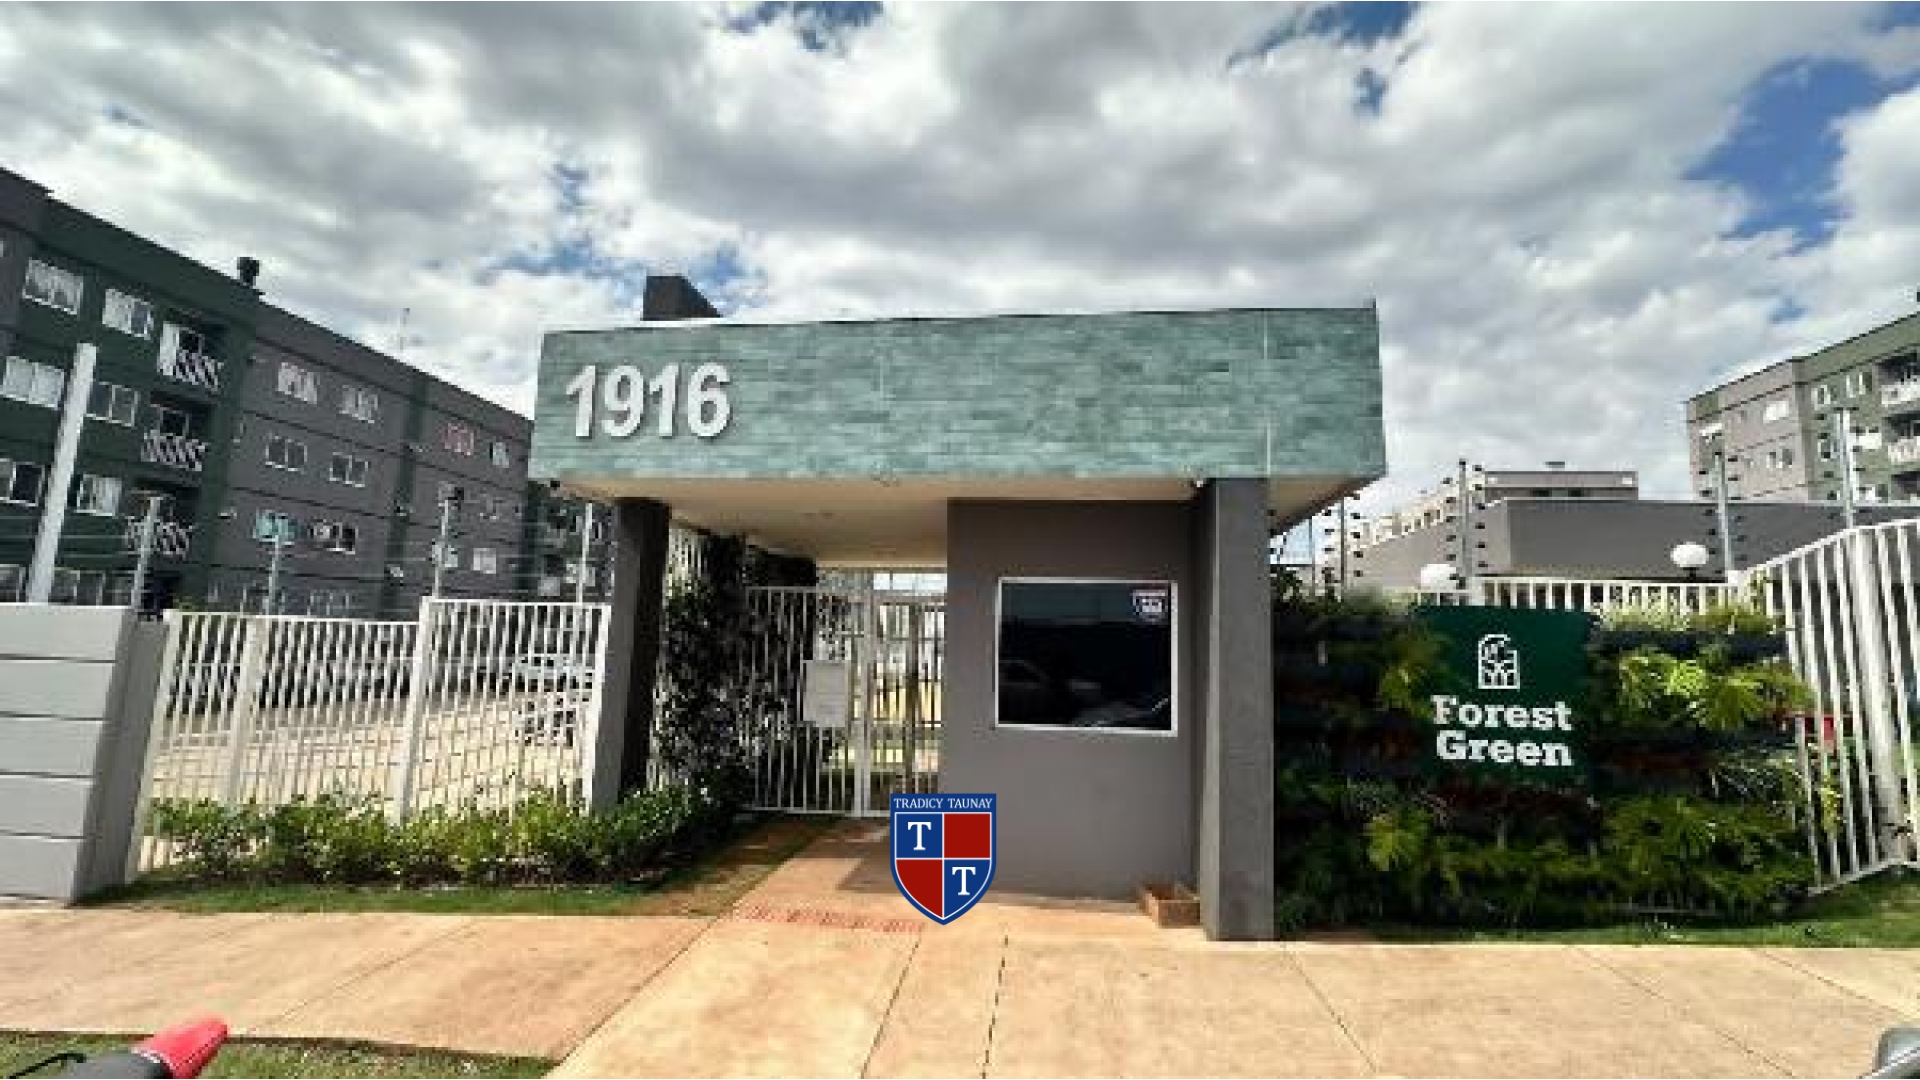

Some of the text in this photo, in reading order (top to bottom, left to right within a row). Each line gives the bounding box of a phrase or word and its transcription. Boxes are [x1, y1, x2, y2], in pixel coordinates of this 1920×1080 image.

[565, 362, 732, 438] 1916
[1430, 694, 1574, 731] Forest
[1436, 730, 1575, 767] Green
